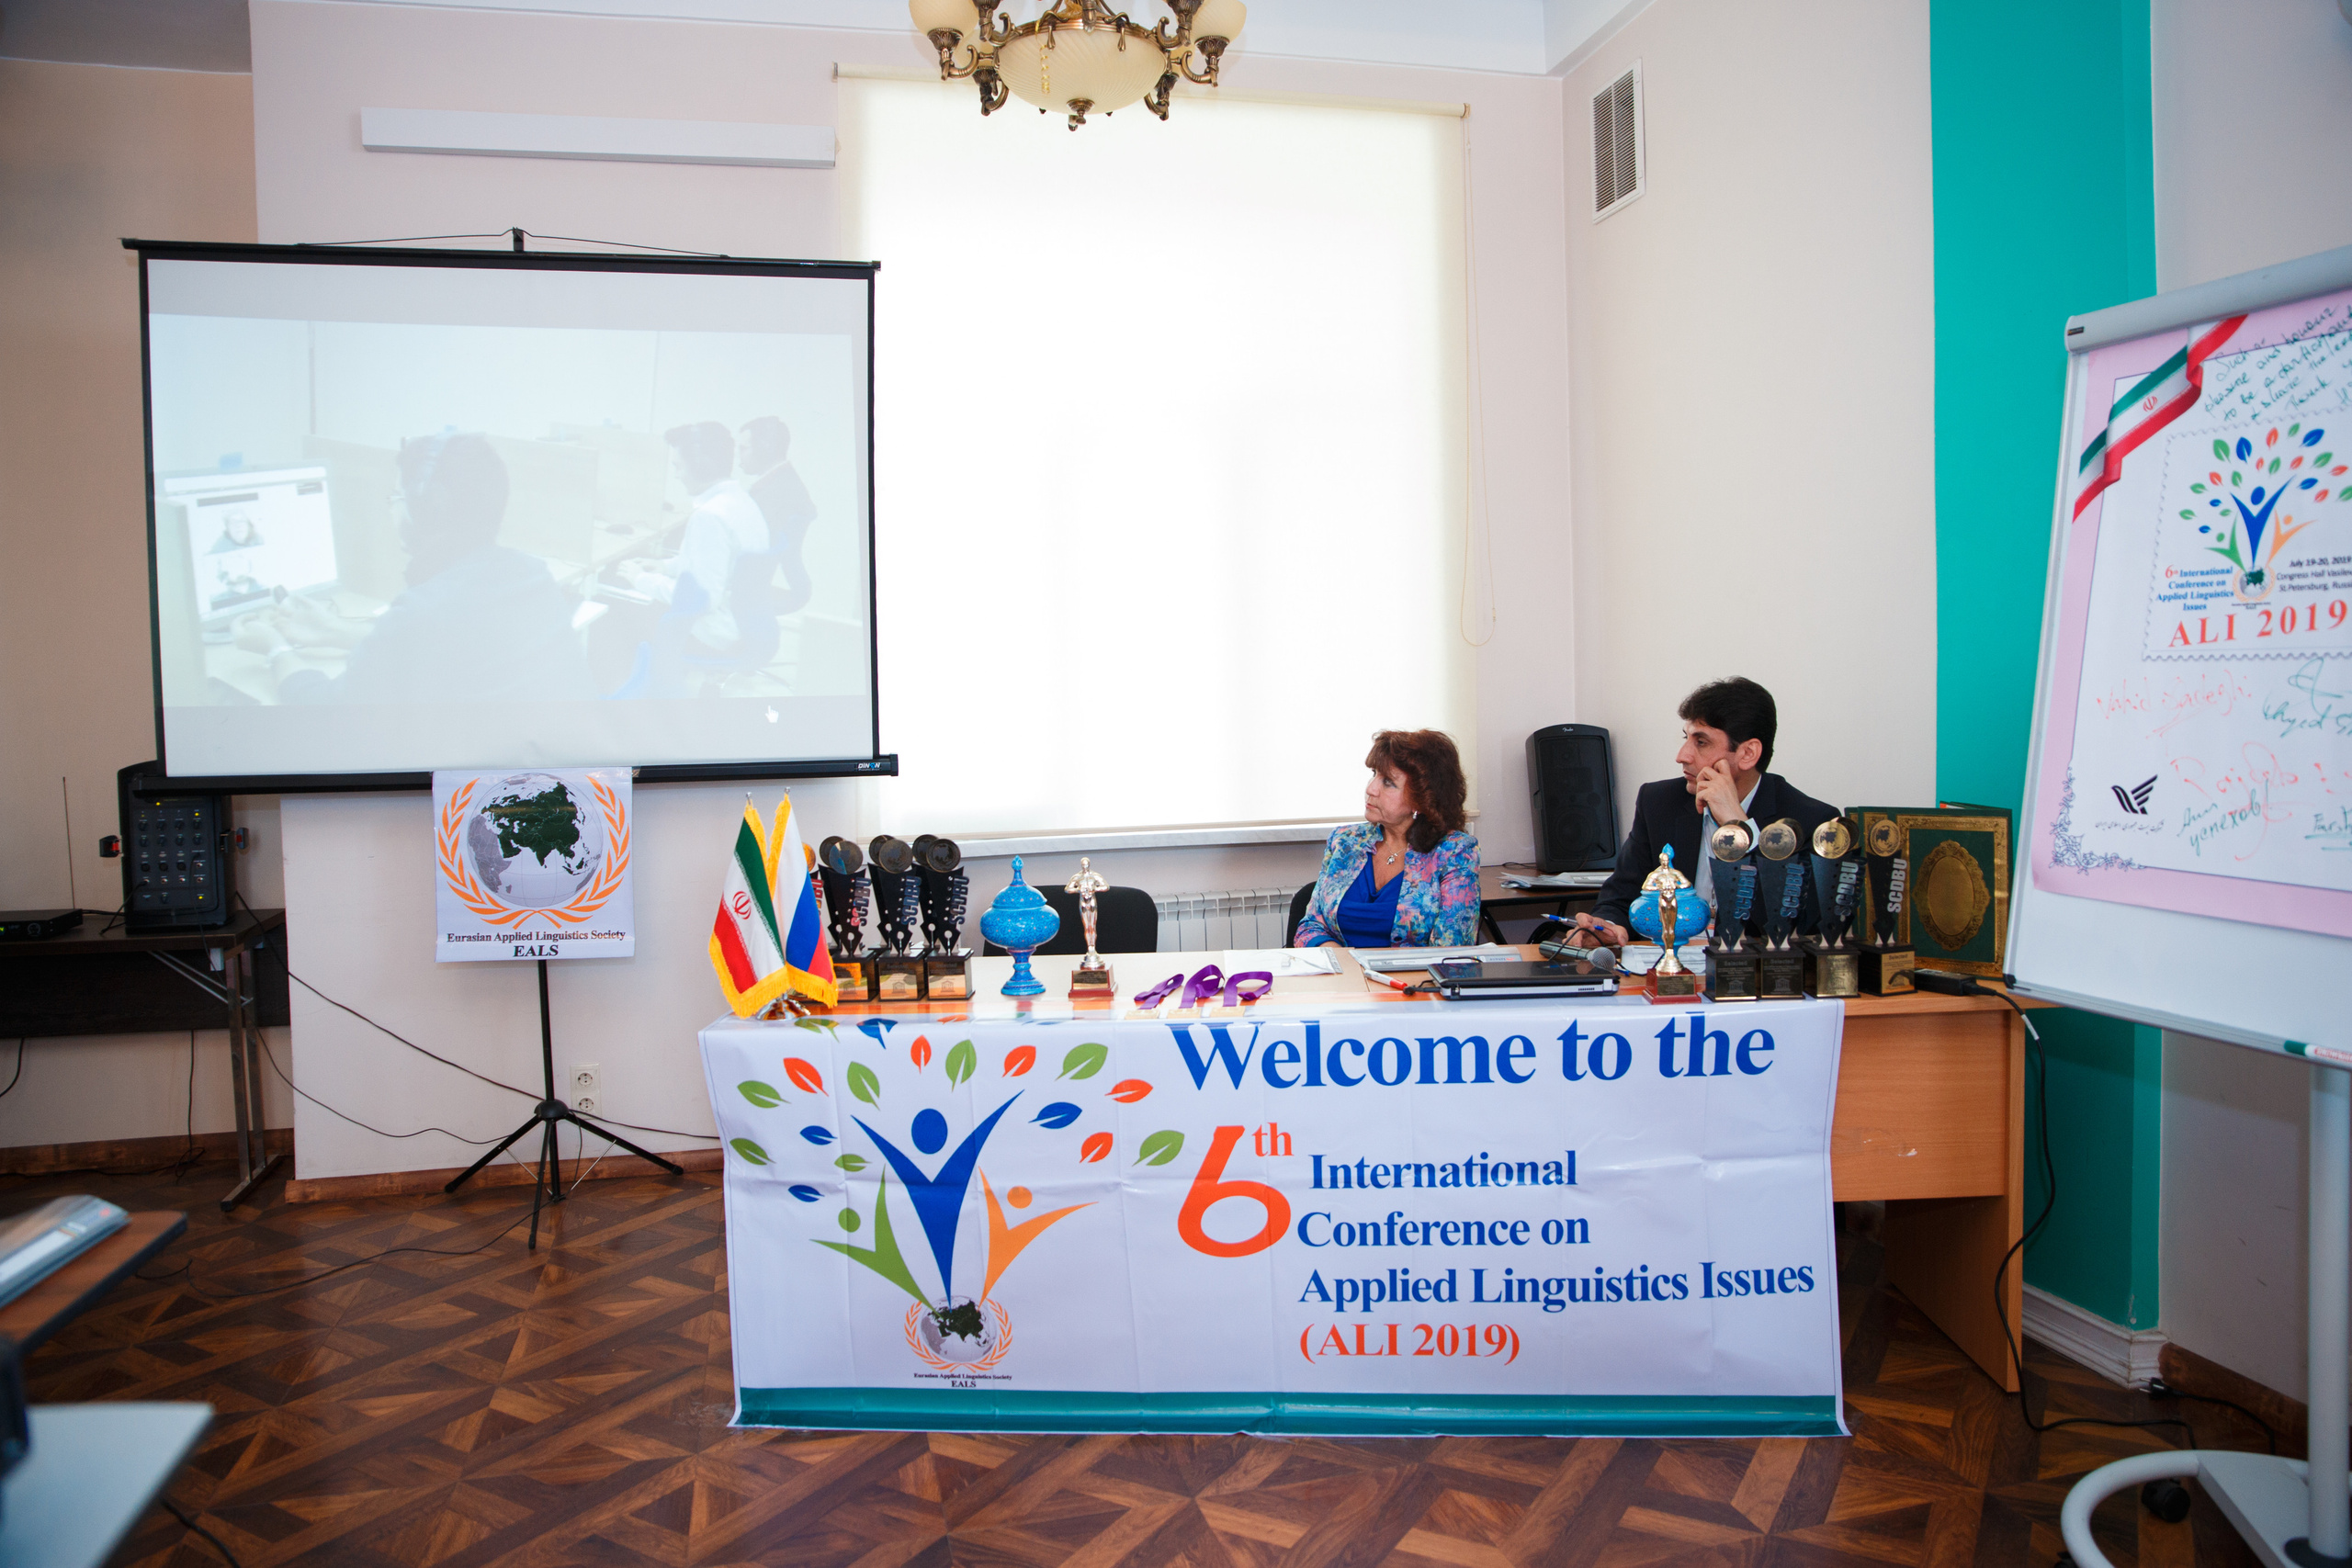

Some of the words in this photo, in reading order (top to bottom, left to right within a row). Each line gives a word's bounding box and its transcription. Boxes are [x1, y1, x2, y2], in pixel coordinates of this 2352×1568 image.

[2155, 592, 2188, 603] Applied
[2190, 590, 2234, 600] Linguistics
[2168, 581, 2214, 589] Conference
[2180, 566, 2233, 578] International
[2168, 613, 2237, 648] ALI
[2256, 600, 2348, 637] 2019
[2183, 603, 2207, 611] Issues
[849, 876, 872, 927] SCDBU
[900, 875, 922, 926] SCDBU
[948, 875, 970, 925] SCDBU
[1733, 864, 1757, 920] SCDBU
[1780, 863, 1805, 919] SCDBU
[1834, 861, 1859, 917] SCDBU
[1887, 857, 1907, 914] SCDBU
[447, 932, 492, 942] Eurasian
[493, 931, 533, 943] Applied
[535, 931, 589, 943] Linguistics
[591, 930, 626, 942] Society
[513, 945, 559, 957] EALS
[1165, 1020, 1537, 1091] Welcome
[1556, 1019, 1633, 1082] to
[1654, 1011, 1776, 1078] the
[1177, 1122, 1294, 1258] 6th
[1310, 1150, 1578, 1190] International
[1296, 1211, 1531, 1247] Conference
[1541, 1217, 1591, 1246] on
[1298, 1267, 1459, 1314] Applied
[1471, 1263, 1690, 1314] Linguistics
[1700, 1261, 1815, 1299] Issues
[1300, 1324, 1401, 1365] (ALI
[1412, 1324, 1521, 1366] 2019)
[951, 1380, 977, 1388] EALS
